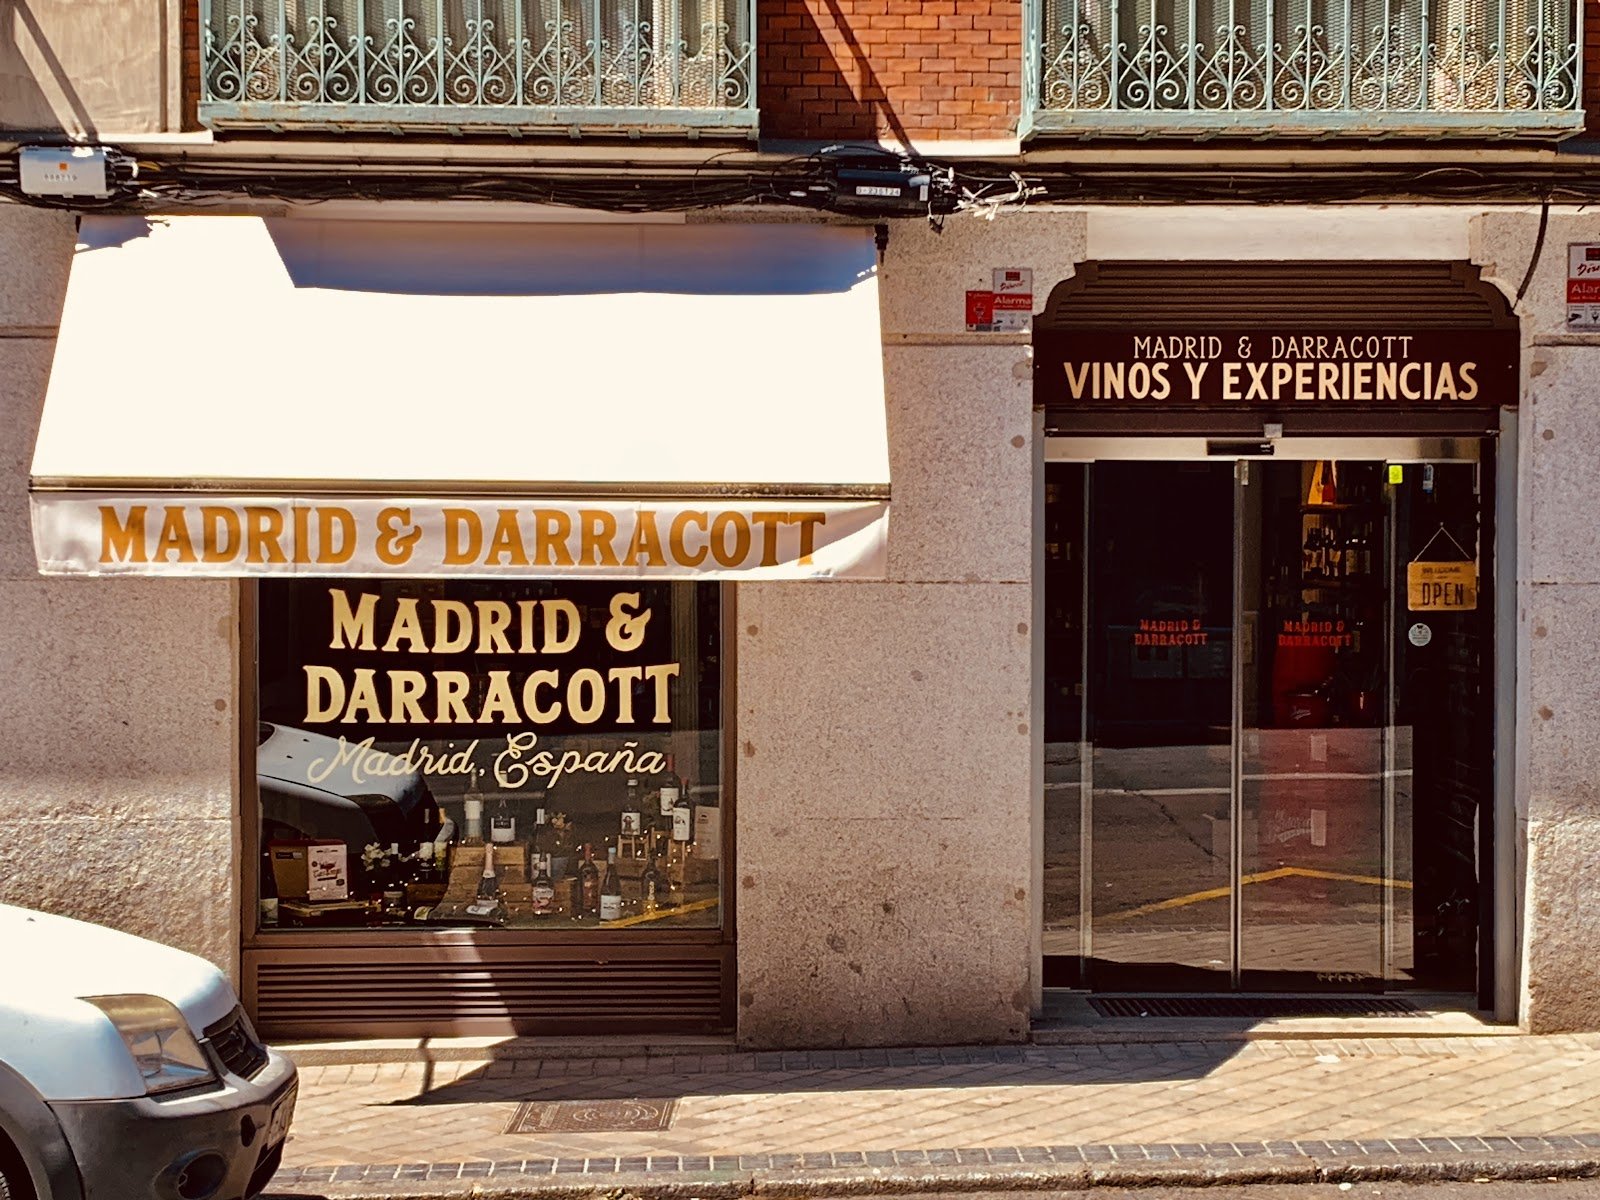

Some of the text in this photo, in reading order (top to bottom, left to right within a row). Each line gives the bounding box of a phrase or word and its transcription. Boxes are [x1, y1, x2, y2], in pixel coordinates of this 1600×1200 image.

[994, 296, 1031, 304] Alarma
[1134, 336, 1412, 358] MADRID & DARRACOTT
[1064, 362, 1477, 400] VINOS Y EXPERIENCIAS
[100, 506, 825, 567] MADRID & DARRACOTT
[1422, 582, 1464, 607] OPEN
[330, 589, 651, 654] MADRID &
[1140, 619, 1187, 632] MADRID
[1283, 619, 1331, 633] MADRID
[1134, 633, 1208, 647] DARRACOTT
[303, 664, 679, 724] DARRACOTT
[307, 731, 666, 789] Madrid, España
